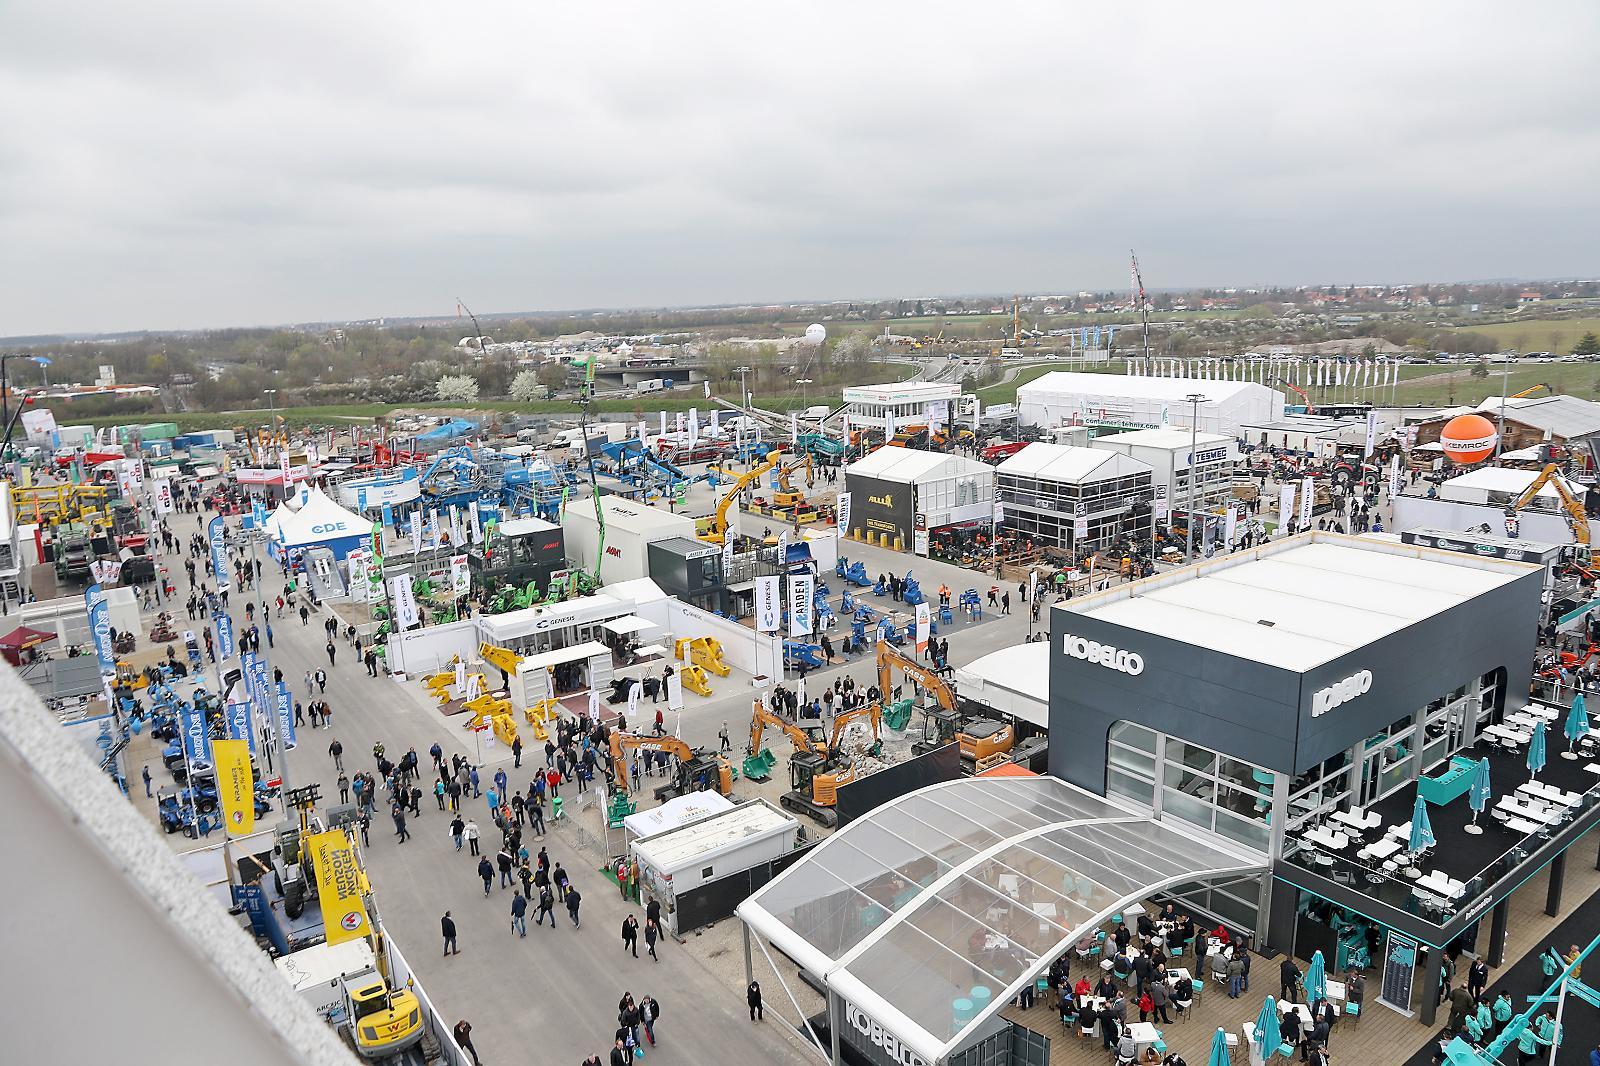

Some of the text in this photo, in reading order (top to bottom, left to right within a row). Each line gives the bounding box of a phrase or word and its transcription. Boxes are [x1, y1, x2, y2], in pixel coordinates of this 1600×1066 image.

[1445, 440, 1489, 450] KEMROC
[1195, 448, 1227, 463] TESMEC
[311, 522, 347, 534] CDE
[606, 546, 622, 558] AVANT
[795, 580, 805, 615] ARDEN
[550, 615, 576, 626] GENESIS
[1063, 633, 1144, 676] KOBELCO
[902, 665, 926, 682] CASE
[189, 713, 206, 760] MULTIONE
[992, 730, 1010, 744] CASE
[836, 769, 851, 782] CASE
[232, 767, 241, 802] KRAMER
